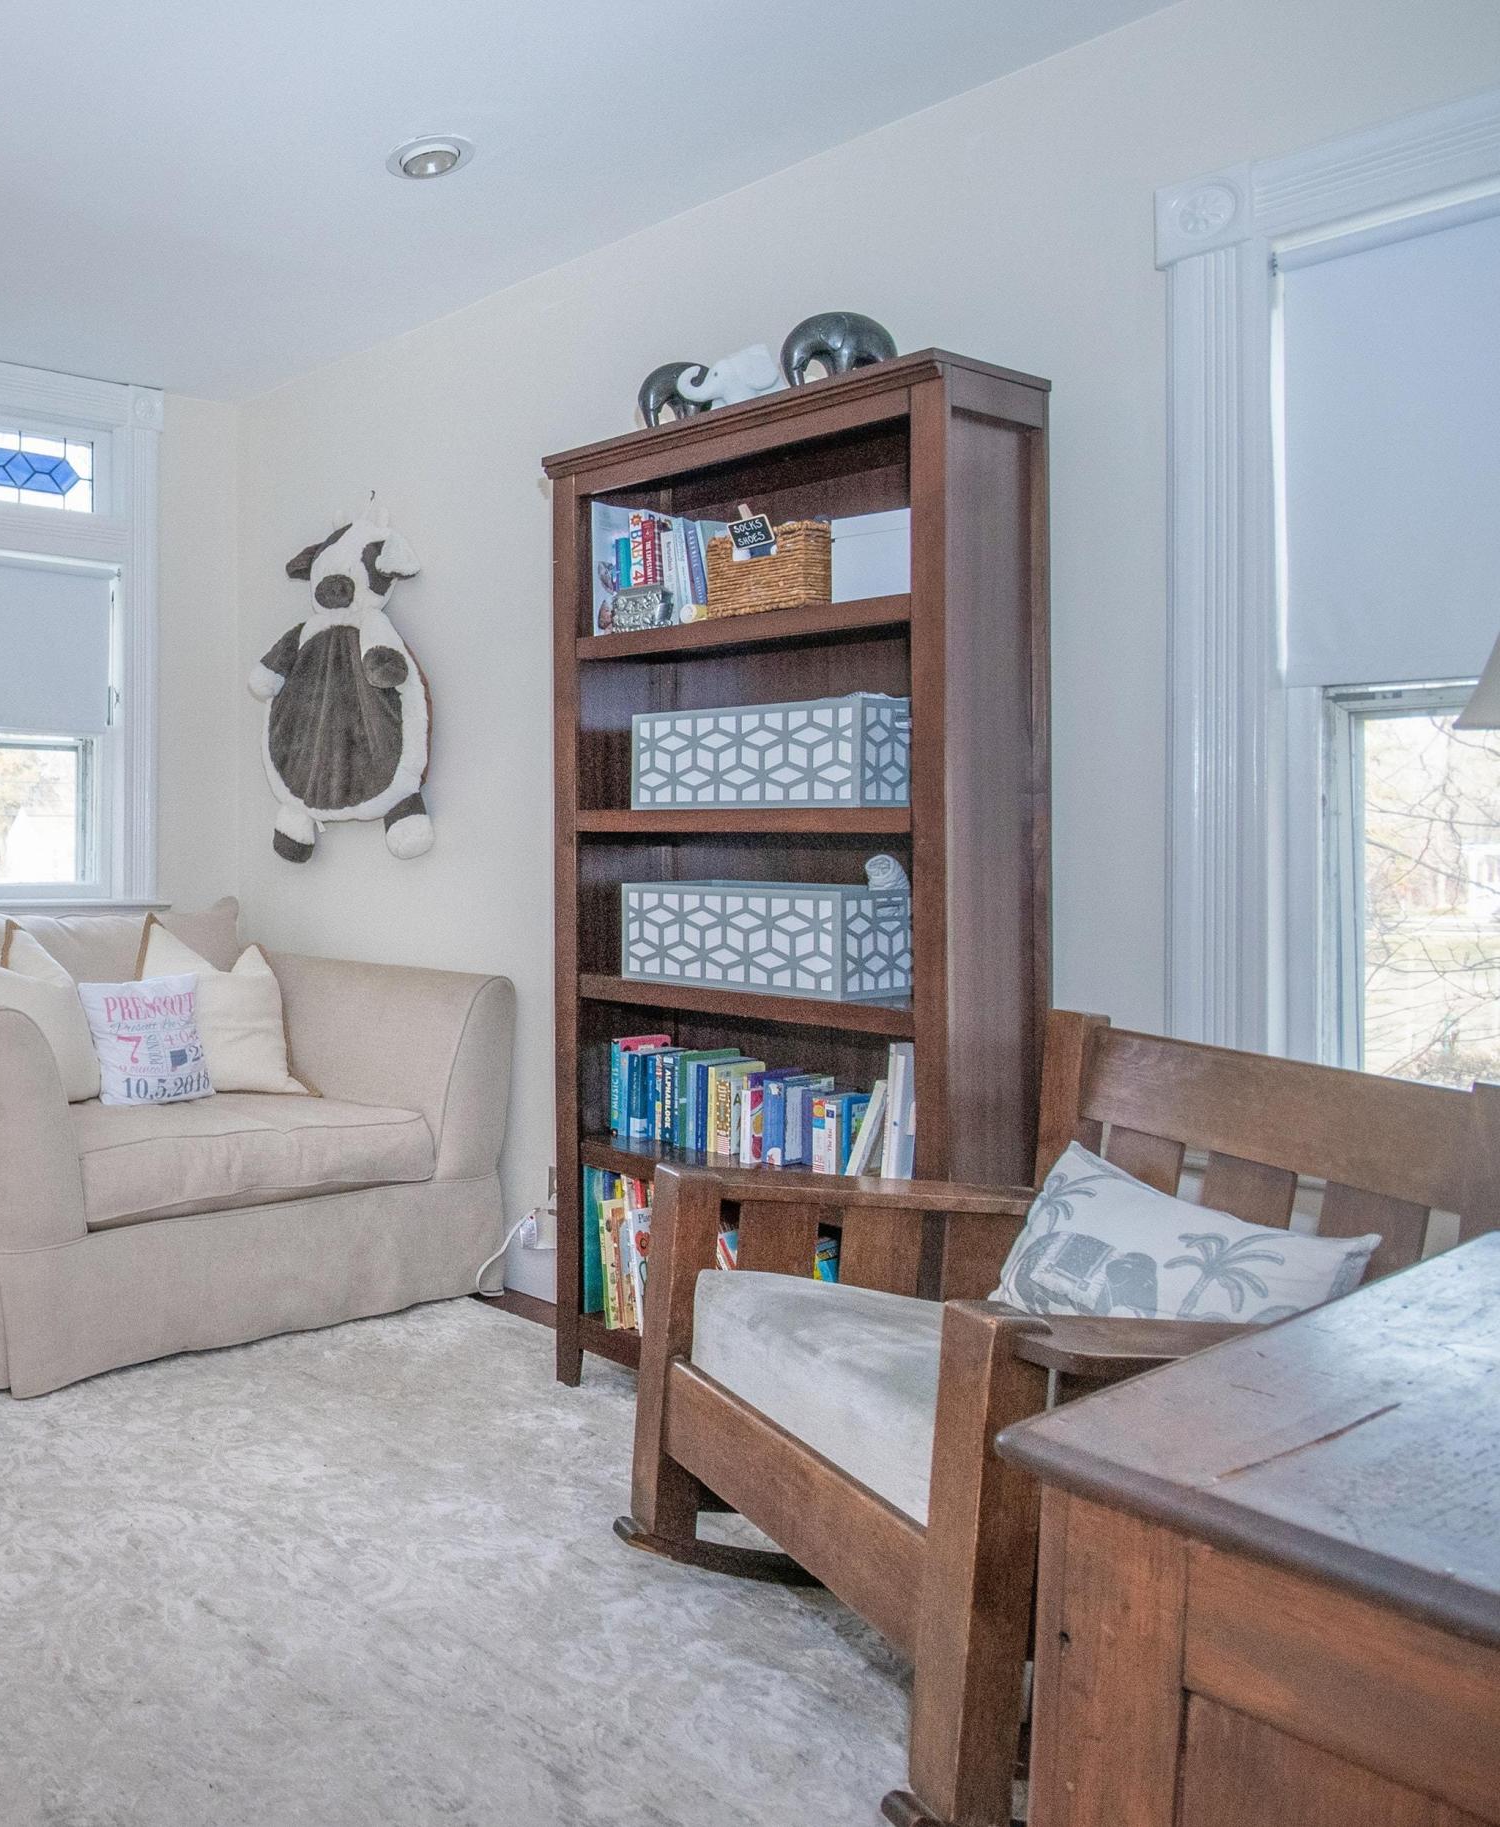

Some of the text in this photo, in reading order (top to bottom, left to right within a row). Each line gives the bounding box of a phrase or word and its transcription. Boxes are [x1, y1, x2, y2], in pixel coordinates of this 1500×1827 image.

[733, 518, 763, 534] SOCKS
[737, 531, 766, 546] SHOES
[630, 529, 644, 568] BABY
[104, 992, 194, 1022] PRESCOTT
[116, 1036, 142, 1063] 7
[122, 1073, 210, 1099] 10.5.2018
[611, 1078, 619, 1109] MUSIC
[664, 1068, 672, 1129] ALPHABLOCK
